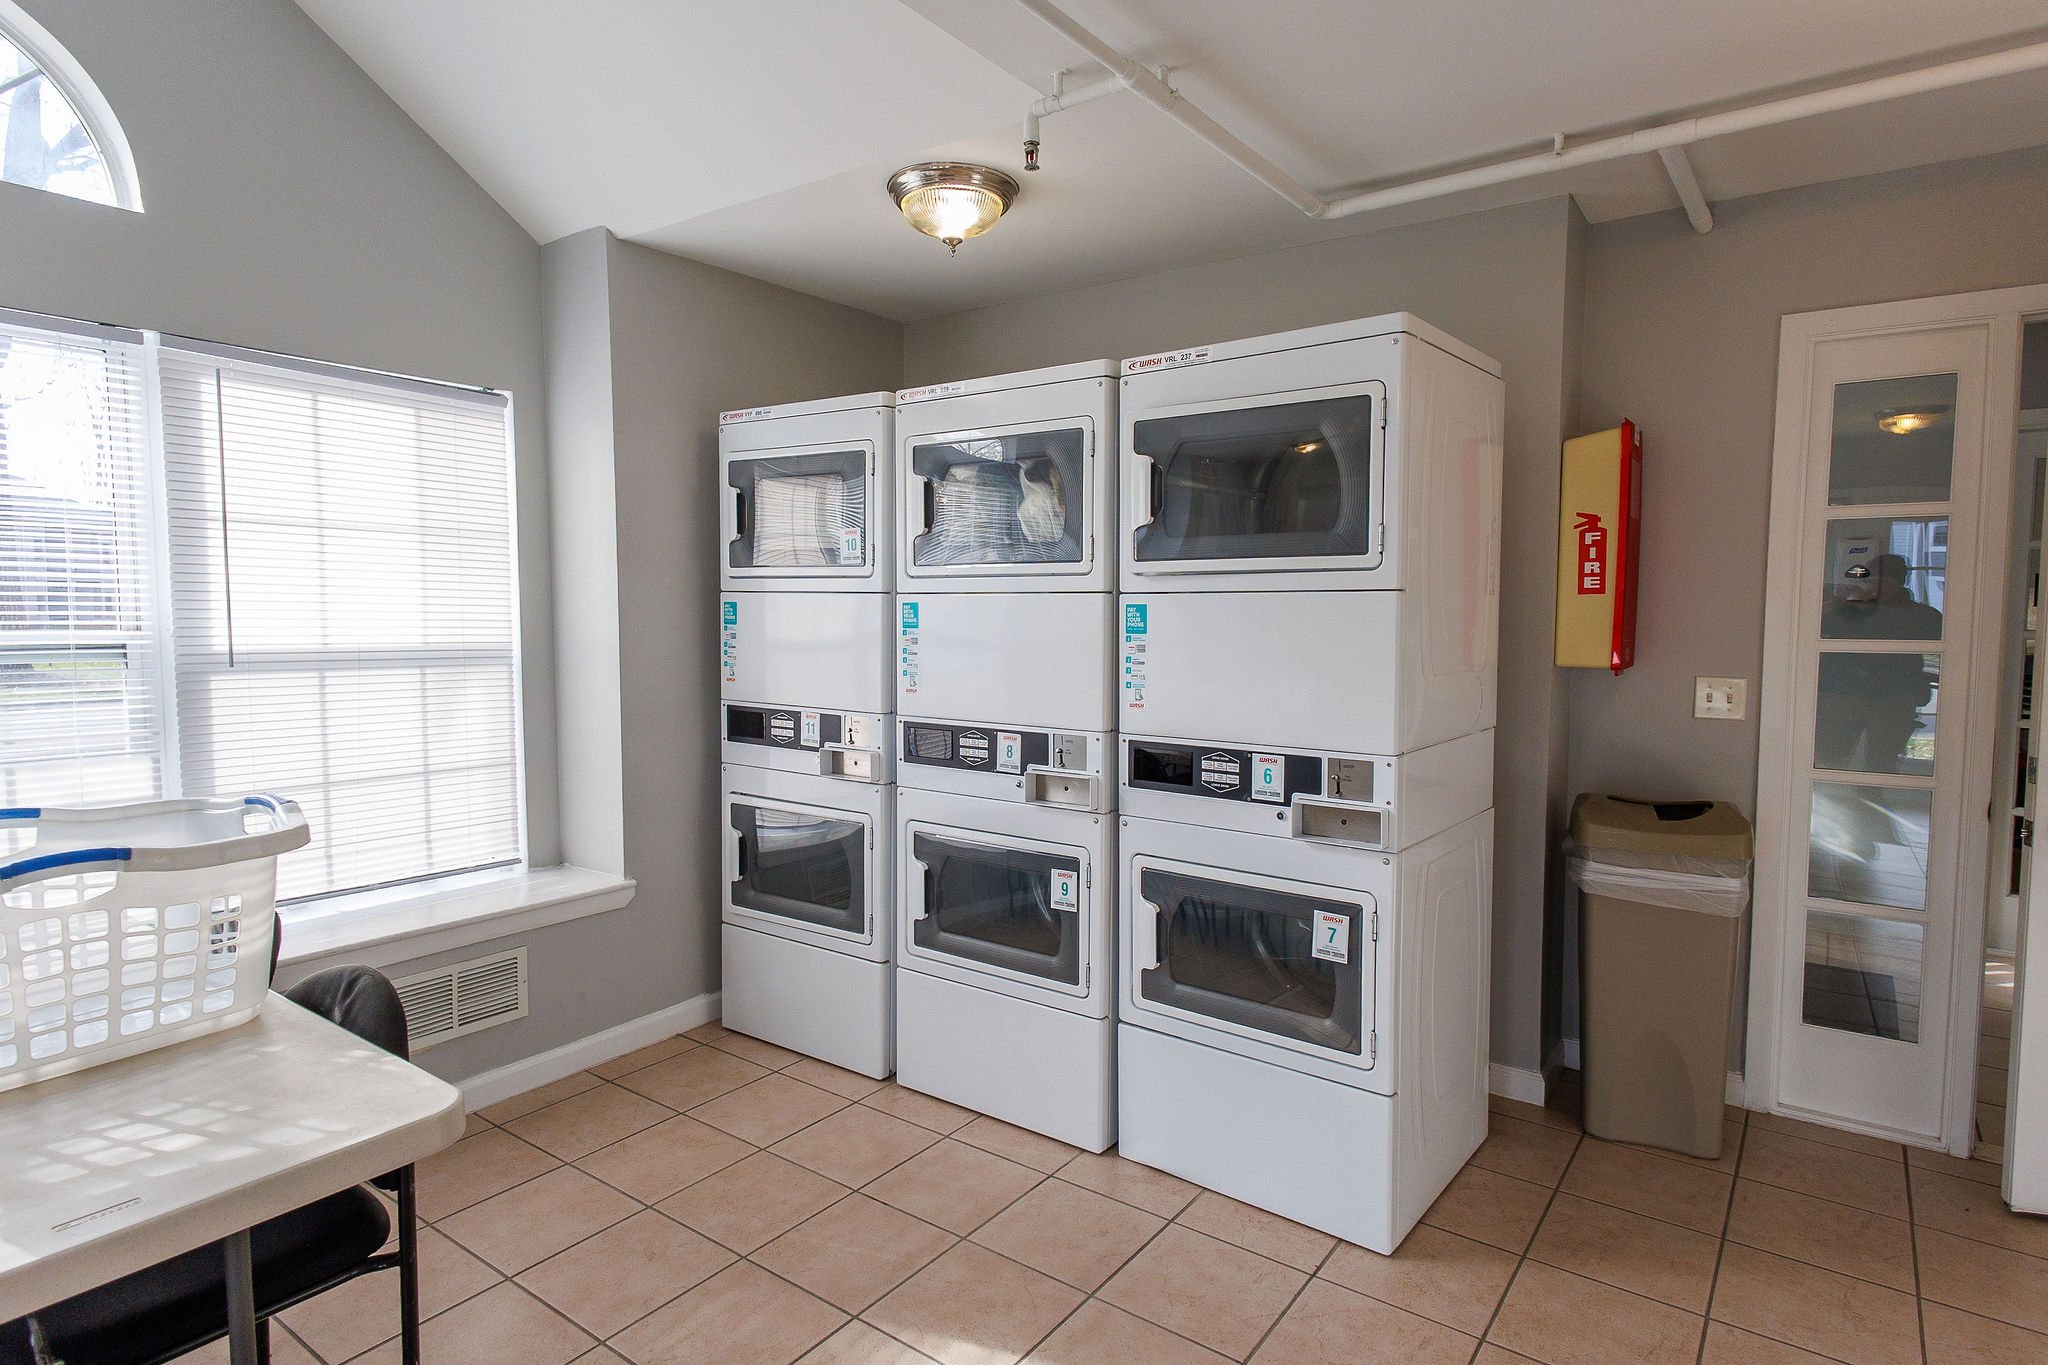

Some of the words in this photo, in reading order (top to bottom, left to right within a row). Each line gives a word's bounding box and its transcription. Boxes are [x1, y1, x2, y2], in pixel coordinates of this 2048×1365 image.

[1139, 357, 1162, 367] WASH
[1180, 353, 1192, 361] 237
[845, 538, 857, 551] 10
[1584, 532, 1601, 588] FIRE
[806, 722, 815, 734] 11
[1007, 744, 1013, 758] 8
[1263, 768, 1272, 784] 6
[1061, 882, 1068, 896] 9
[1322, 915, 1344, 924] WASH
[1327, 927, 1337, 943] 7
